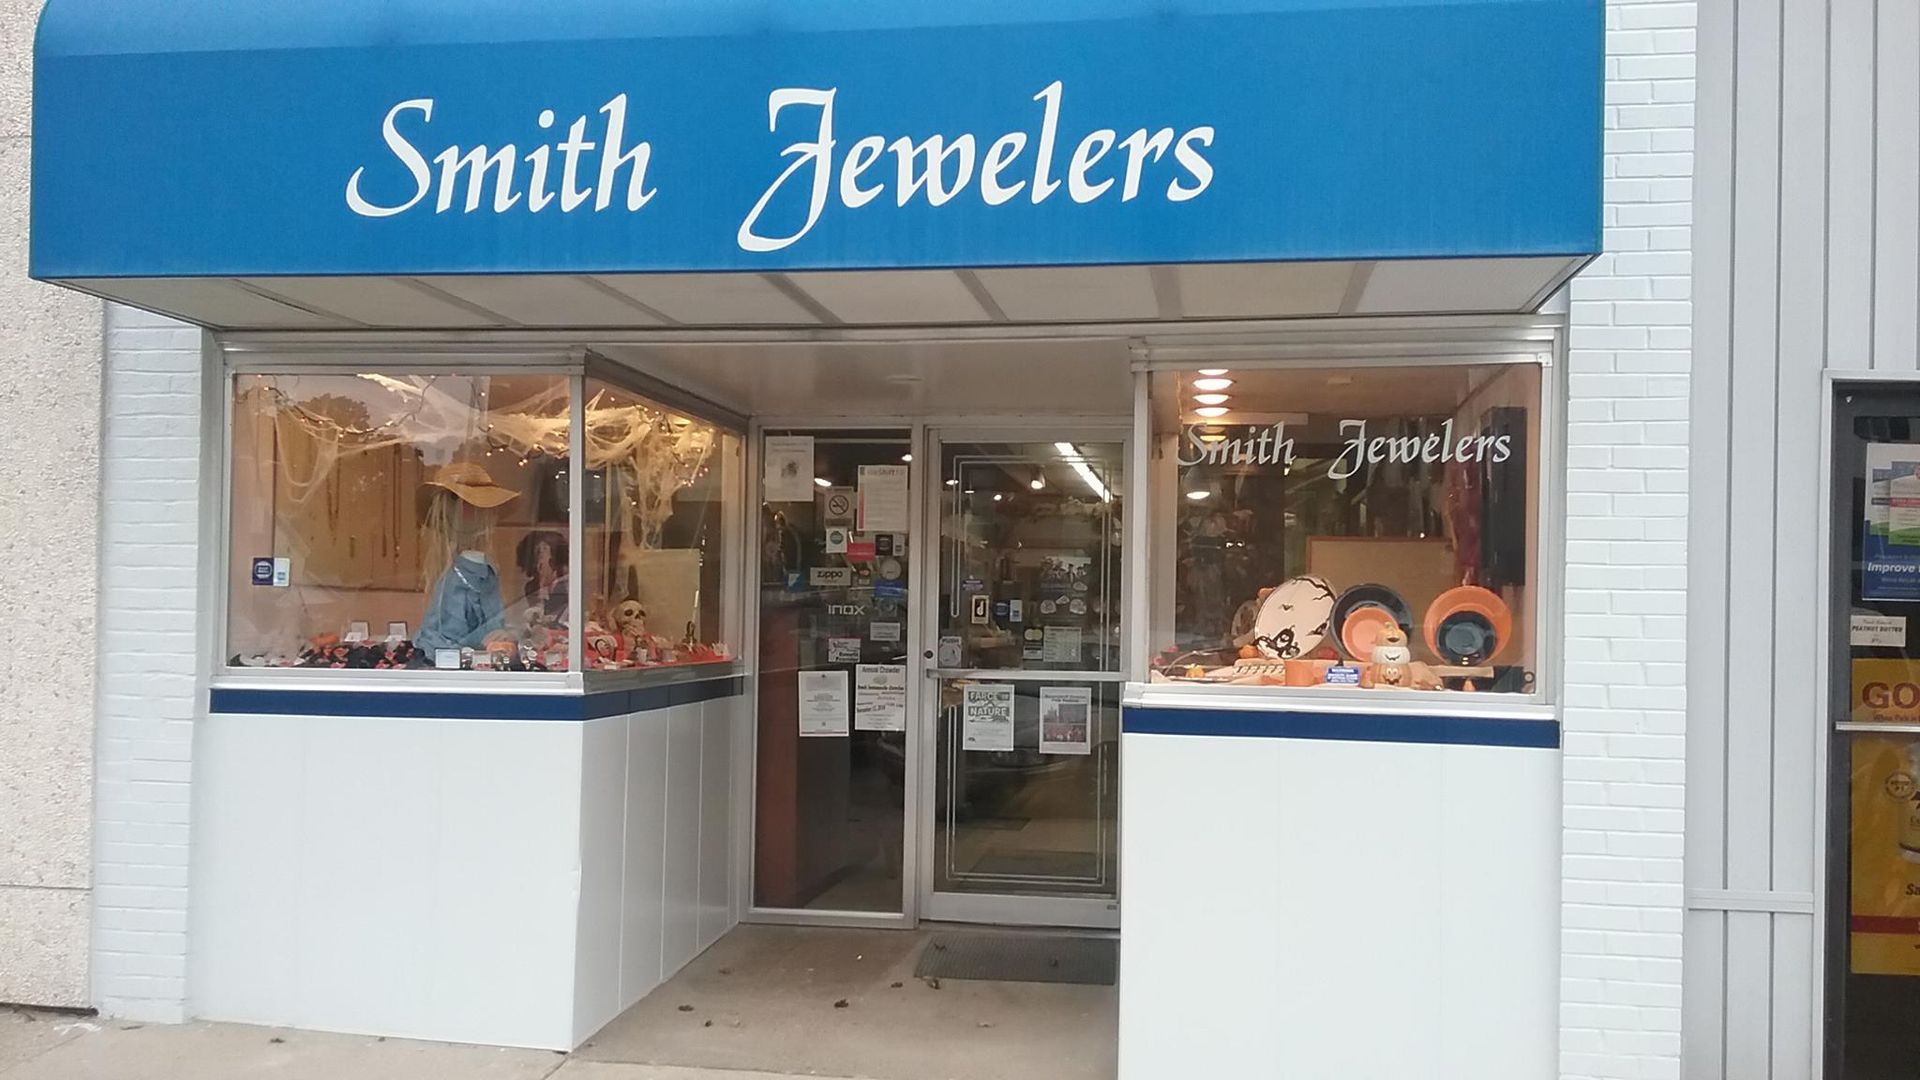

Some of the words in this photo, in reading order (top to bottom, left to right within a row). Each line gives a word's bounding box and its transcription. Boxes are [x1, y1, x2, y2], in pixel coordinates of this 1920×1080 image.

[346, 94, 656, 216] Smith
[738, 81, 1215, 252] Jewelers
[1177, 420, 1297, 466] Smith
[1328, 418, 1511, 479] Jewelers
[1867, 562, 1915, 574] Improve
[970, 707, 1007, 717] NATURE
